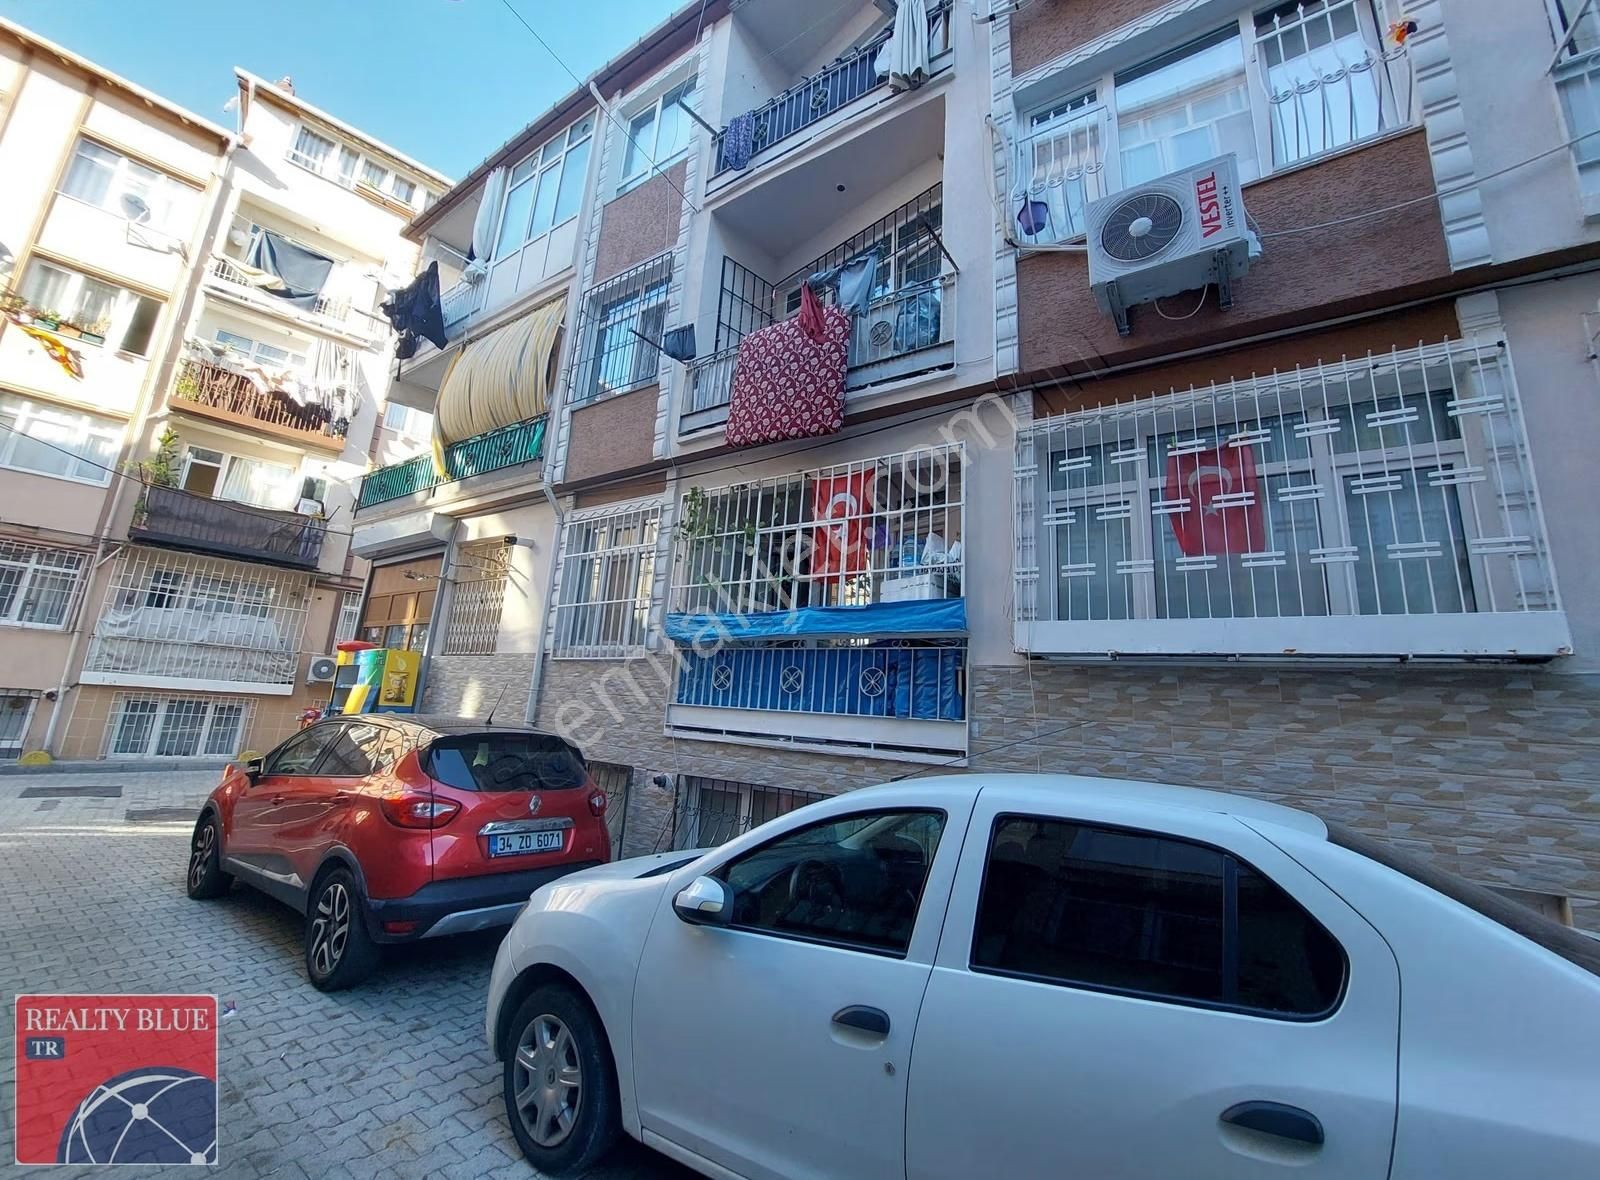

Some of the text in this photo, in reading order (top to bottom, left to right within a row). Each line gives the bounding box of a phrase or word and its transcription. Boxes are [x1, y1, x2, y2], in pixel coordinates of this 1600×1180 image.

[1196, 171, 1222, 238] VESTEL
[499, 836, 512, 851] 34
[537, 832, 560, 848] 6071
